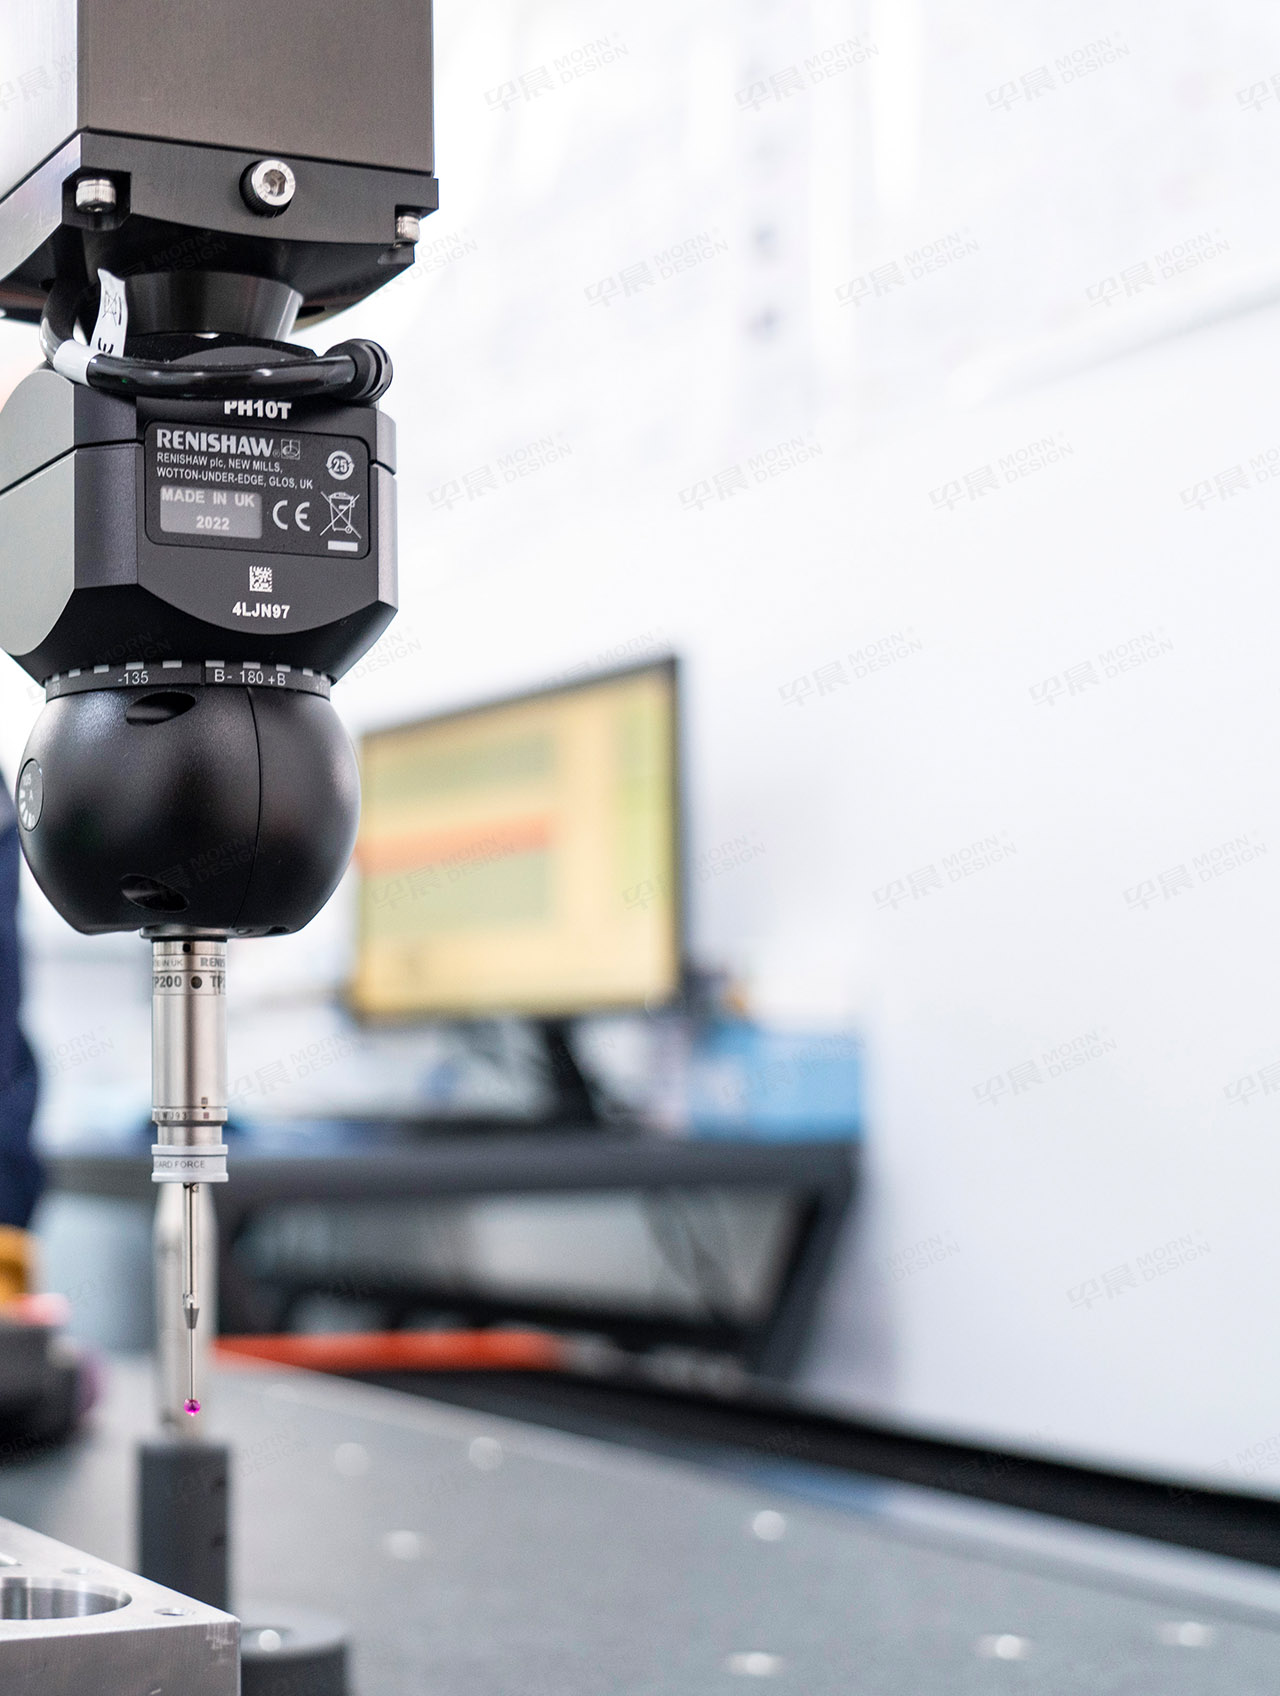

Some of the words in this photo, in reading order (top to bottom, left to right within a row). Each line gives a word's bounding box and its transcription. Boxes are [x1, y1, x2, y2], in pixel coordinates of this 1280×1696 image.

[224, 400, 292, 419] PH10T
[156, 429, 274, 457] RENISHAW
[157, 452, 208, 466] RENISHAW
[210, 458, 226, 469] plc,
[228, 459, 251, 470] NEW
[252, 461, 283, 474] MILLS,
[333, 459, 348, 473] 25
[156, 467, 267, 487] WOTTON-UNDER-EDGE,
[269, 476, 298, 489] GLOS,
[300, 479, 313, 489] UK
[162, 489, 205, 504] MADE
[213, 492, 227, 505] IN
[235, 494, 255, 507] UK
[196, 516, 230, 530] 2022
[232, 602, 291, 619] 4LJN97
[118, 670, 149, 685] -135
[240, 671, 264, 685] 180
